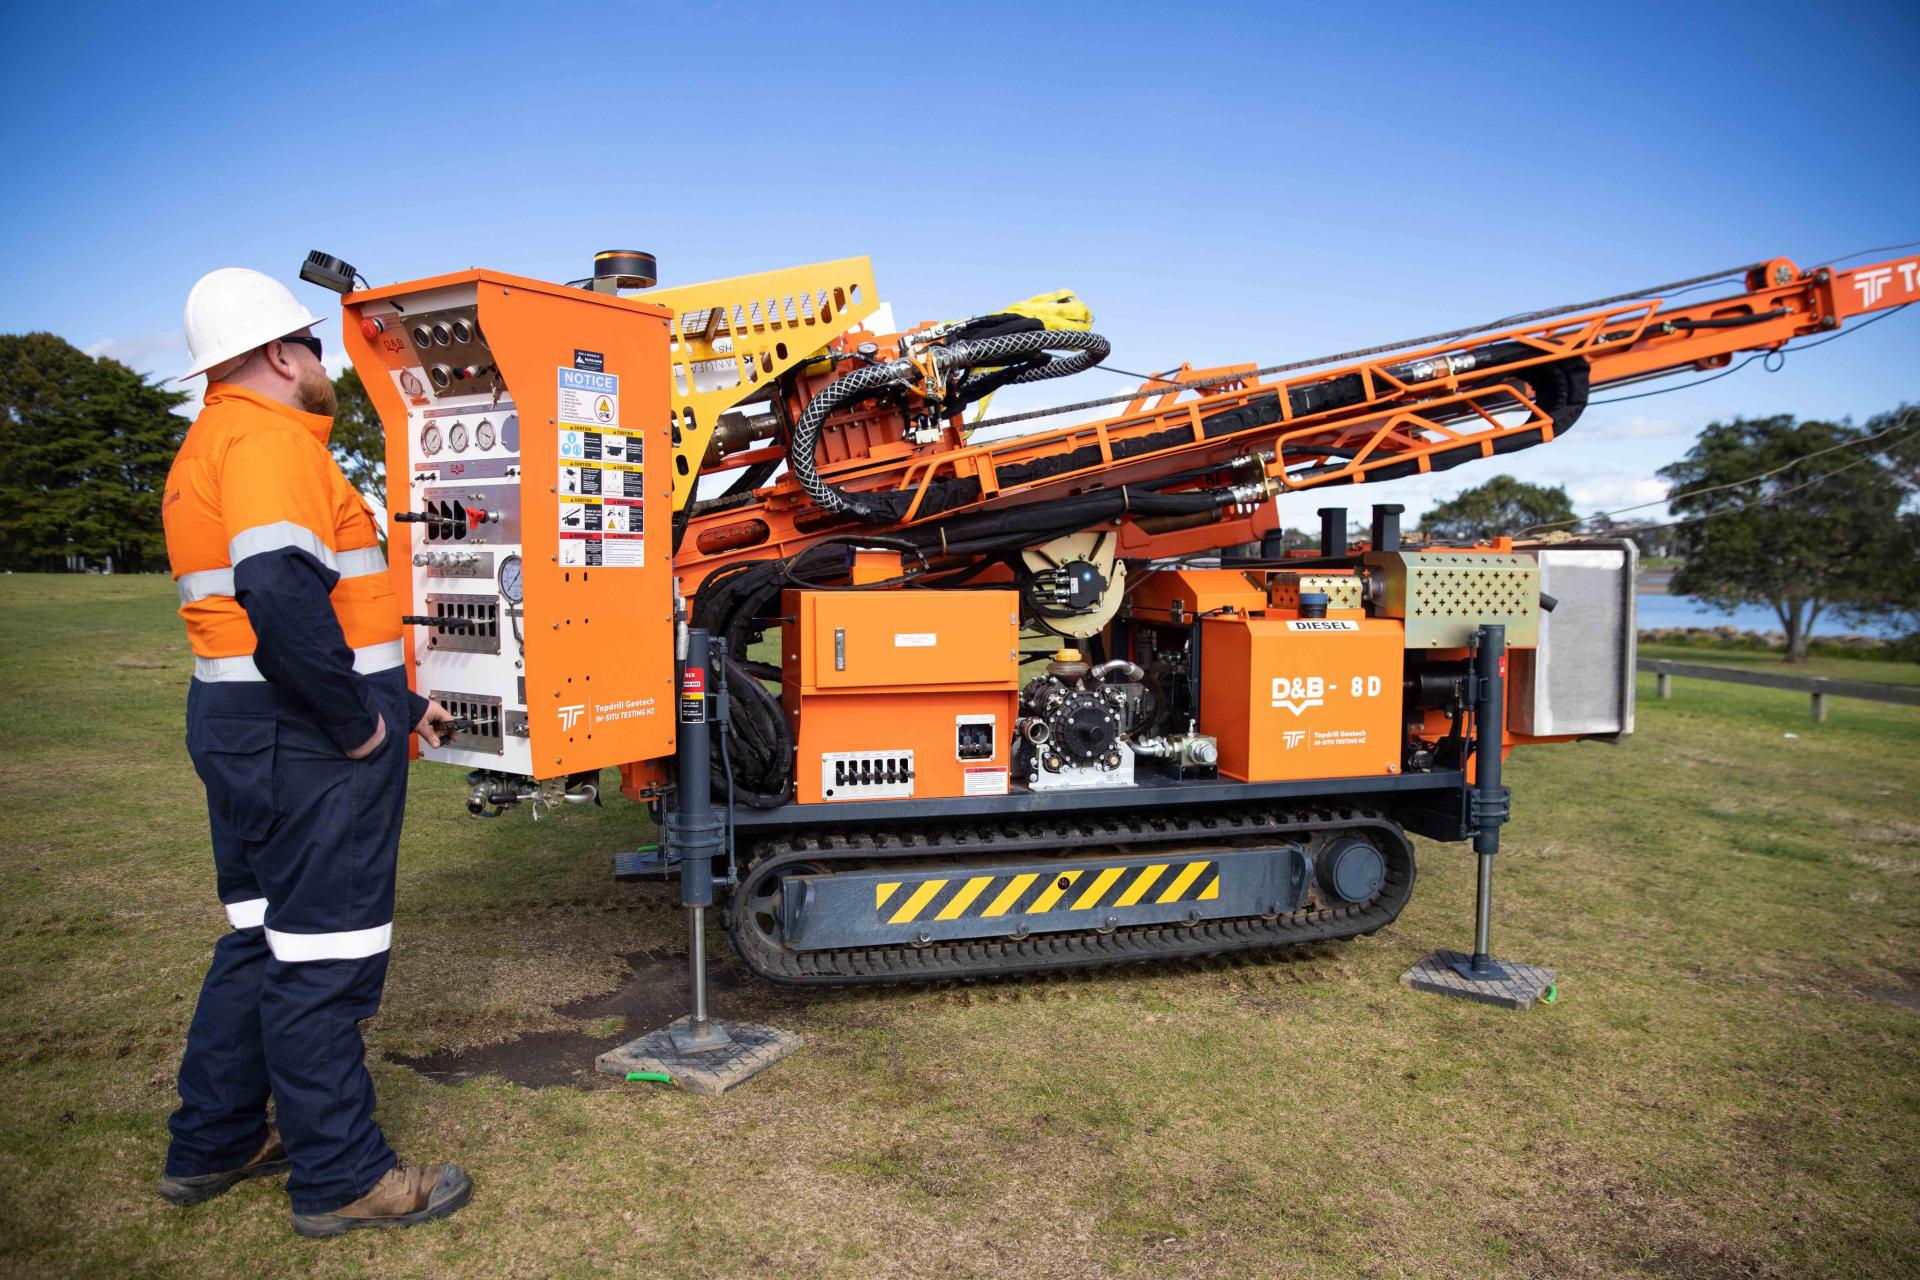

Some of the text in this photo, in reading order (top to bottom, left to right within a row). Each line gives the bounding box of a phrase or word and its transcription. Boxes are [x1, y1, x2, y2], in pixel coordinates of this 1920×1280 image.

[564, 371, 613, 389] NOTICE
[1295, 621, 1351, 630] DIESEL
[594, 697, 655, 714] Topdrill Geotech
[595, 712, 620, 722] IN-SITU
[621, 708, 646, 719] TESTING
[1313, 729, 1367, 739] Topdrill Geotech
